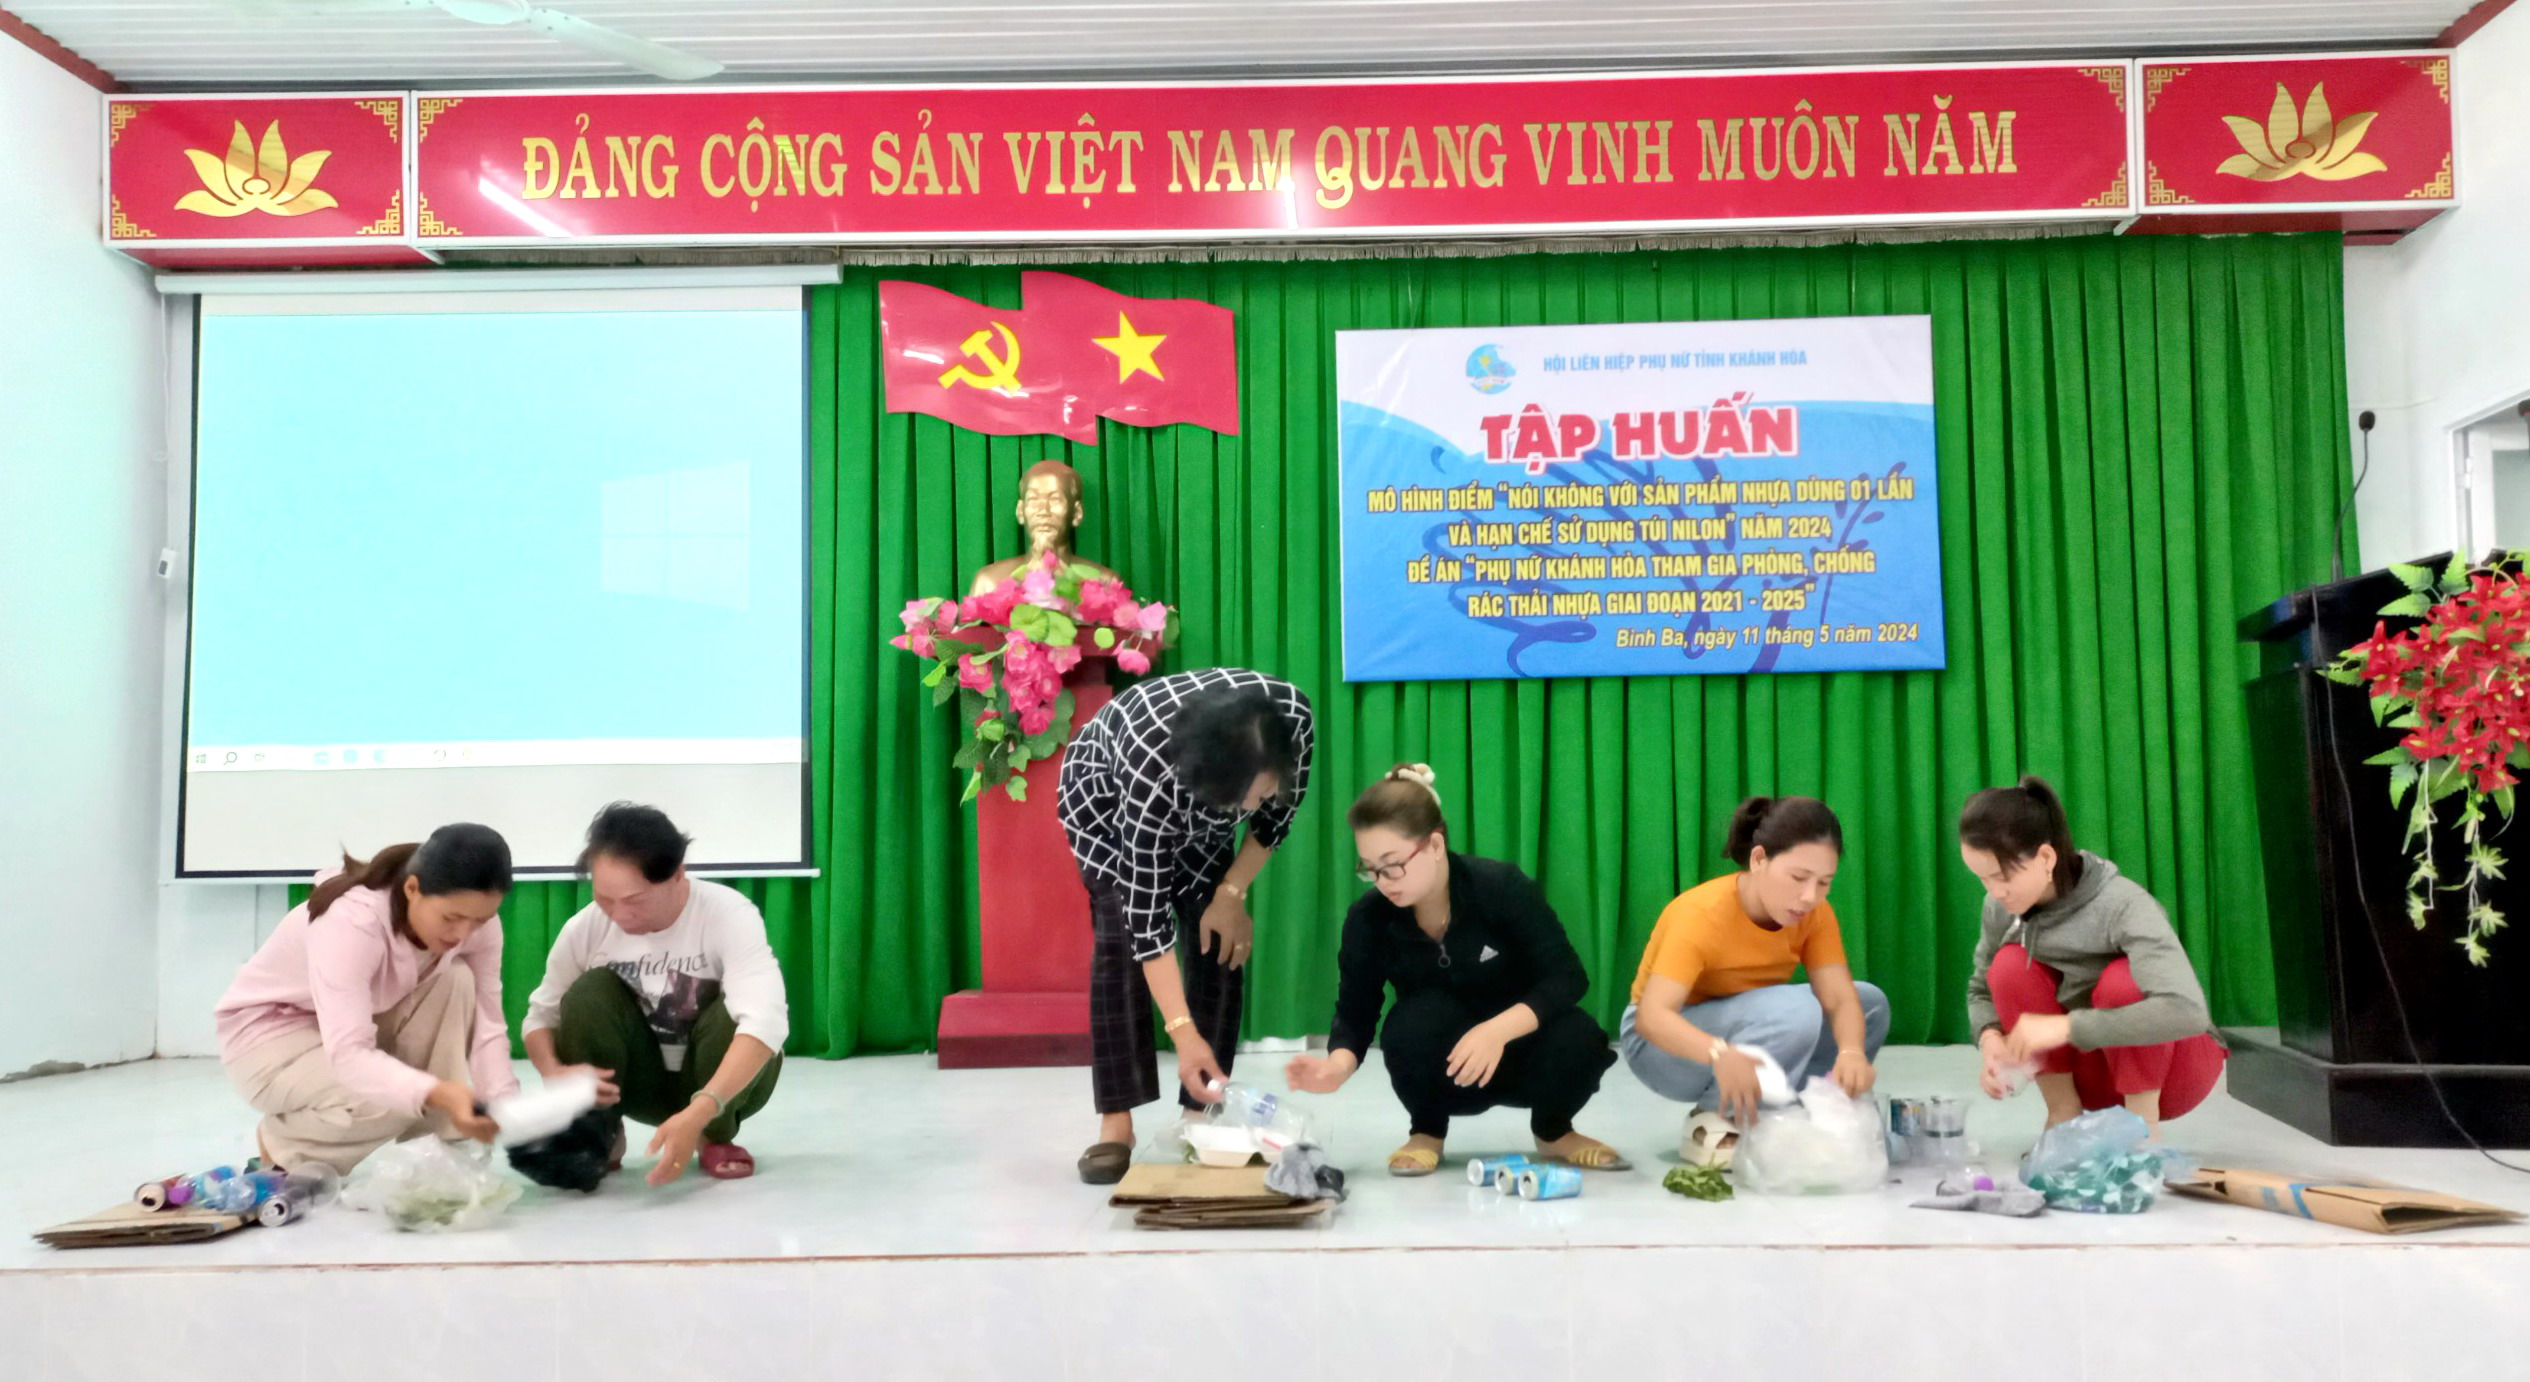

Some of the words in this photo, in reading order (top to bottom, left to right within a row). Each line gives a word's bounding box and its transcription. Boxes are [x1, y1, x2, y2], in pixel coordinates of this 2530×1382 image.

[522, 112, 680, 201] ĐẢNG
[701, 115, 848, 214] CỘNG
[869, 108, 985, 196] SẢN
[1003, 112, 1145, 209] VIỆT
[1167, 127, 1296, 194] NAM
[1314, 122, 1508, 210] QUANG
[1523, 119, 1675, 186] VINH
[1697, 98, 1860, 183] MUÔN
[1883, 94, 2019, 177] NĂM
[1543, 353, 1566, 375] HỘI
[1570, 352, 1600, 371] LIÊN
[1604, 351, 1635, 373] HIỆP
[1639, 353, 1666, 373] PHỤ
[1670, 350, 1691, 369] NỮ
[1694, 348, 1725, 368] TỈNH
[1729, 348, 1776, 367] KHÁNH
[1479, 402, 1599, 474] TẬP
[1611, 390, 1796, 459] HUẤN
[1368, 485, 1397, 512] MÔ
[1401, 484, 1443, 512] HÌNH
[1448, 480, 1494, 510] ĐIỂM
[1543, 482, 1604, 508] KHÔNG
[1609, 480, 1638, 507] VỚI
[1642, 475, 1680, 506] SẢN
[1684, 474, 1737, 506] PHẨM
[1742, 478, 1792, 508] NHỰA
[1796, 475, 1846, 503] DÙNG
[1850, 479, 1871, 501] 01
[1448, 520, 1473, 547] VÀ
[1476, 523, 1513, 550] HẠN
[1518, 517, 1553, 545] CHẾ
[1557, 515, 1583, 544] SỬ
[1586, 520, 1635, 548] DỤNG
[1640, 516, 1667, 542] TÚI
[1741, 513, 1783, 540] NĂM
[1788, 516, 1832, 539] 2024
[1407, 555, 1431, 583] ĐỀ
[1435, 553, 1461, 582] ÁN
[1516, 555, 1543, 581] NỮ
[1546, 552, 1606, 580] KHÁNH
[1610, 551, 1647, 578] HÒA
[1652, 555, 1702, 578] THAM
[1707, 553, 1737, 576] GIA
[1742, 548, 1809, 578] PHÒNG,
[1813, 545, 1876, 574] CHỐNG
[1467, 591, 1504, 618] RÁC
[1508, 588, 1547, 617] THẢI
[1552, 591, 1601, 620] NHỰA
[1606, 592, 1642, 616] GIAI
[1647, 590, 1696, 618] ĐOẠN
[1701, 590, 1743, 613] 2021
[1660, 626, 1688, 649] Ba,
[1694, 626, 1737, 650] ngày
[1742, 625, 1760, 645] 11
[1764, 625, 1814, 648] tháng
[1819, 624, 1830, 643] 5
[1834, 624, 1872, 643] năm
[1877, 623, 1920, 642] 2024
